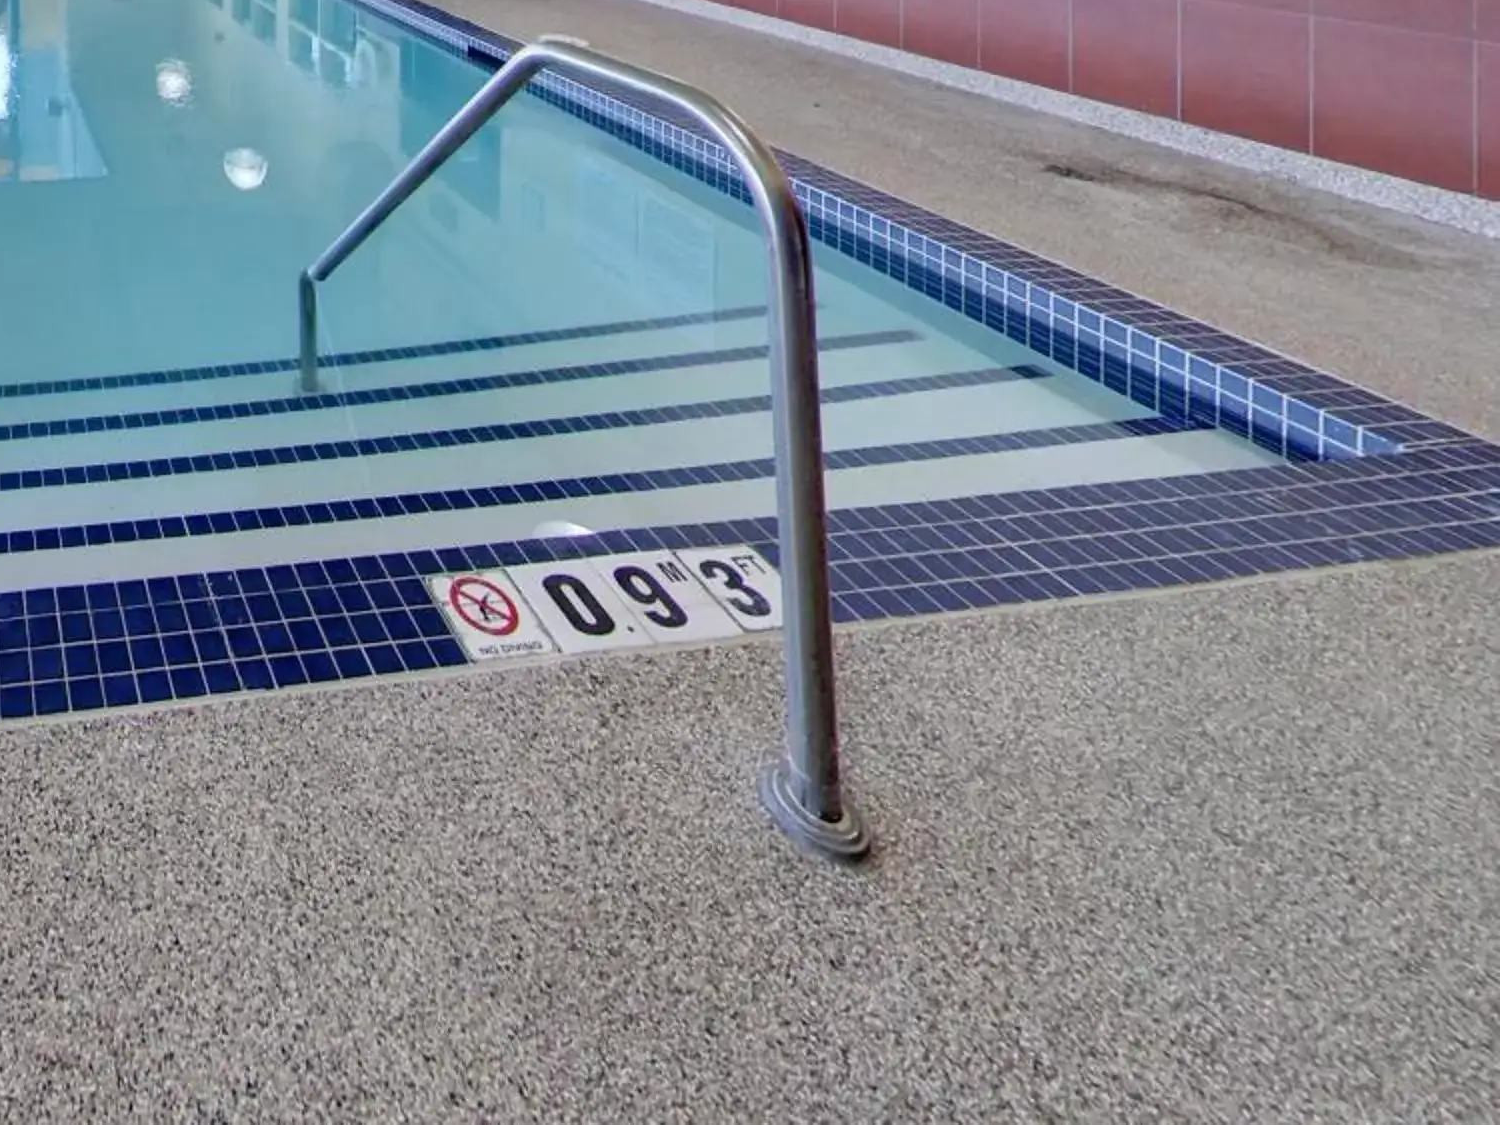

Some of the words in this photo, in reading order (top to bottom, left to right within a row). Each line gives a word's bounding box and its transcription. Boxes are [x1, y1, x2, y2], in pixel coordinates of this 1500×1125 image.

[656, 561, 688, 583] M
[730, 555, 767, 576] FT
[699, 559, 772, 617] 3
